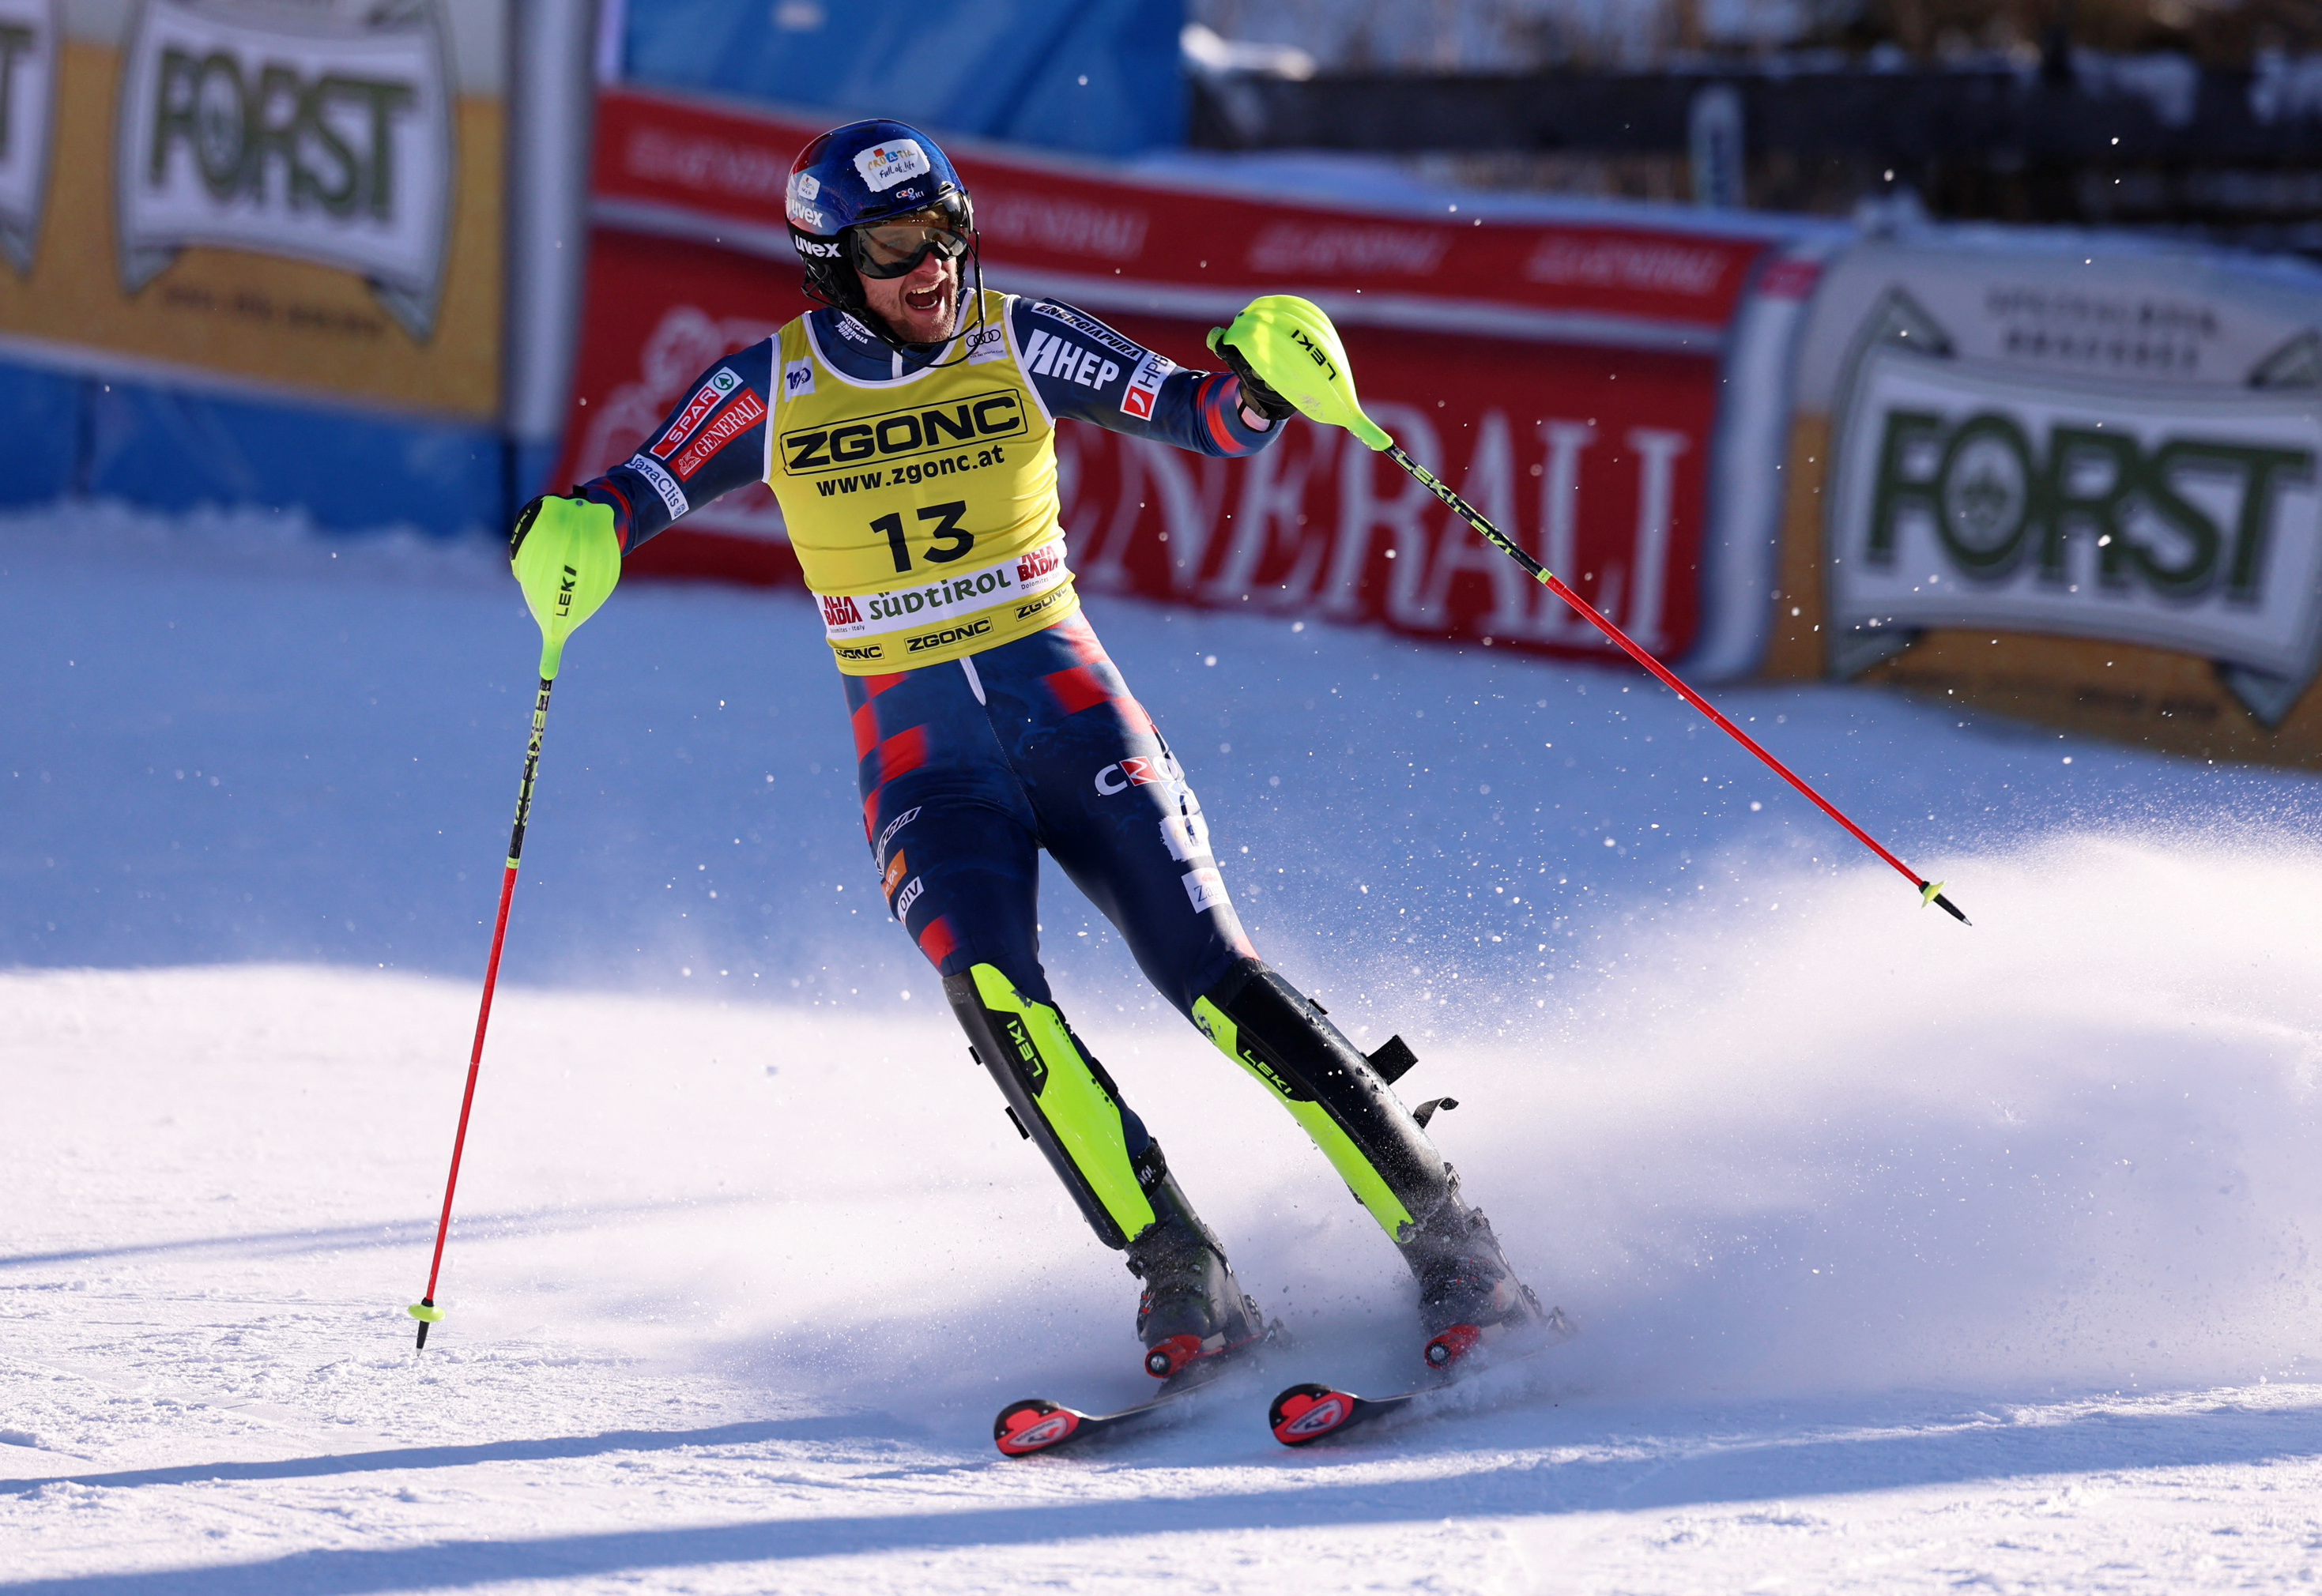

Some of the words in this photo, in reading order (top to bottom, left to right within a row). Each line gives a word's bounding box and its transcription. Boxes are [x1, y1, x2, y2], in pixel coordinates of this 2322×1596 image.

[150, 42, 416, 224] FORST
[868, 149, 915, 171] CROATIA
[792, 198, 823, 228] uvex
[795, 234, 842, 258] uvex
[839, 320, 869, 344] ENERGIA
[1035, 304, 1140, 358] ENERGIAPURA
[1291, 329, 1336, 381] LEKI
[1051, 341, 1120, 391] HEP
[1137, 353, 1169, 389] HPB
[669, 389, 717, 444] SPAR
[695, 395, 765, 458] GENERALI
[786, 395, 1020, 470] ZGONC
[816, 444, 1005, 497] www.zgonc.at
[1862, 408, 2315, 609] FORST
[869, 499, 975, 574] 13
[556, 564, 577, 617] LEKI
[1016, 557, 1059, 582] BADIA
[1020, 578, 1049, 590] Dolomites
[824, 608, 863, 626] BADIA
[907, 619, 991, 652] ZGONC
[899, 879, 918, 912] OIV
[1006, 1019, 1043, 1077] LEKI
[1243, 1049, 1292, 1094] LEKI
